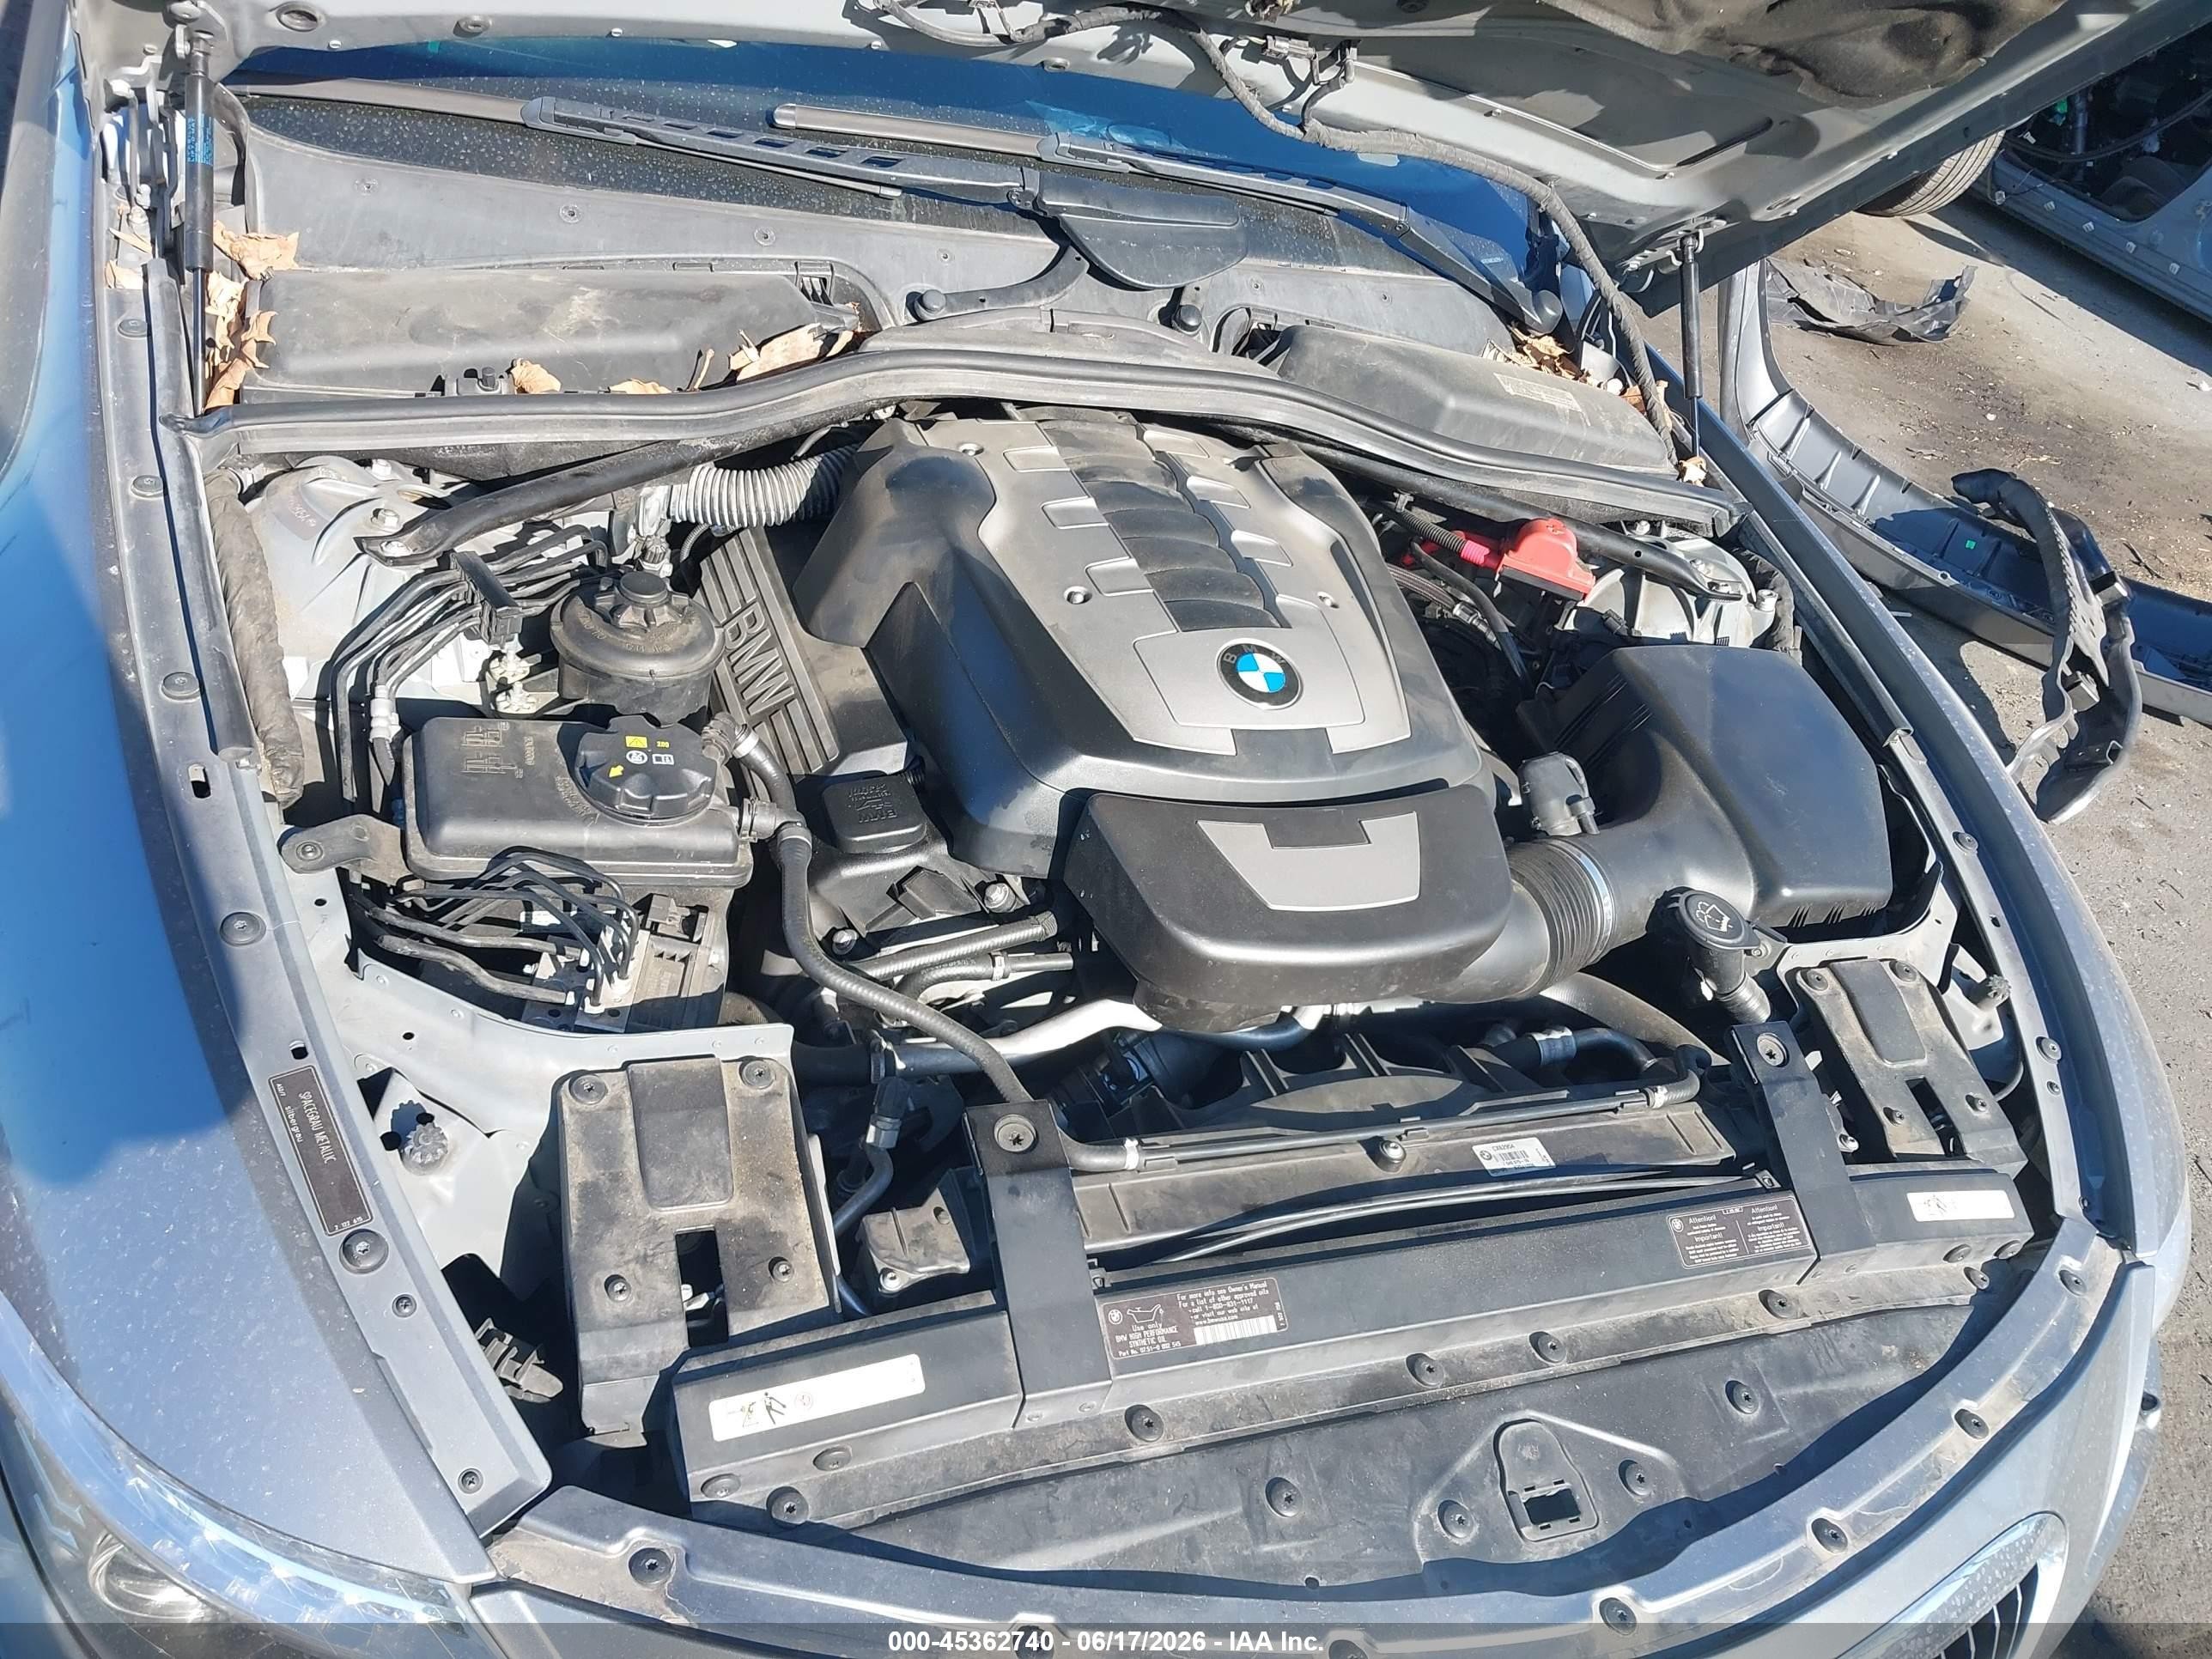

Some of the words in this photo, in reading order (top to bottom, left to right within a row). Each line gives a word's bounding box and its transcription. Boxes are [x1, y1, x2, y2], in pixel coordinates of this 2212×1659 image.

[724, 601, 795, 716] BMW
[1223, 644, 1286, 665] BMW
[284, 1105, 304, 1143] silbergrau
[298, 1091, 324, 1132] SPACEGRAU
[313, 1131, 337, 1164] METALLIC
[1752, 1204, 1778, 1213] Attention!
[1689, 1214, 1717, 1224] Attention!
[1758, 1222, 1785, 1231] Important!
[1694, 1232, 1723, 1243] Important!
[1227, 1284, 1249, 1292] Owner's
[1249, 1280, 1267, 1289] Manual
[1234, 1290, 1257, 1300] approved
[1194, 1315, 1238, 1326] www.bmwusa.com
[1132, 1324, 1145, 1333] Use
[1147, 1321, 1163, 1329] only
[1115, 1334, 1127, 1343] BMW
[1128, 1332, 1142, 1340] HIGH
[1143, 1325, 1179, 1338] PERFORMANCE
[1128, 1338, 1157, 1348] SYNTHETIC
[1157, 1335, 1167, 1344] OIL
[1118, 1349, 1130, 1358] Part
